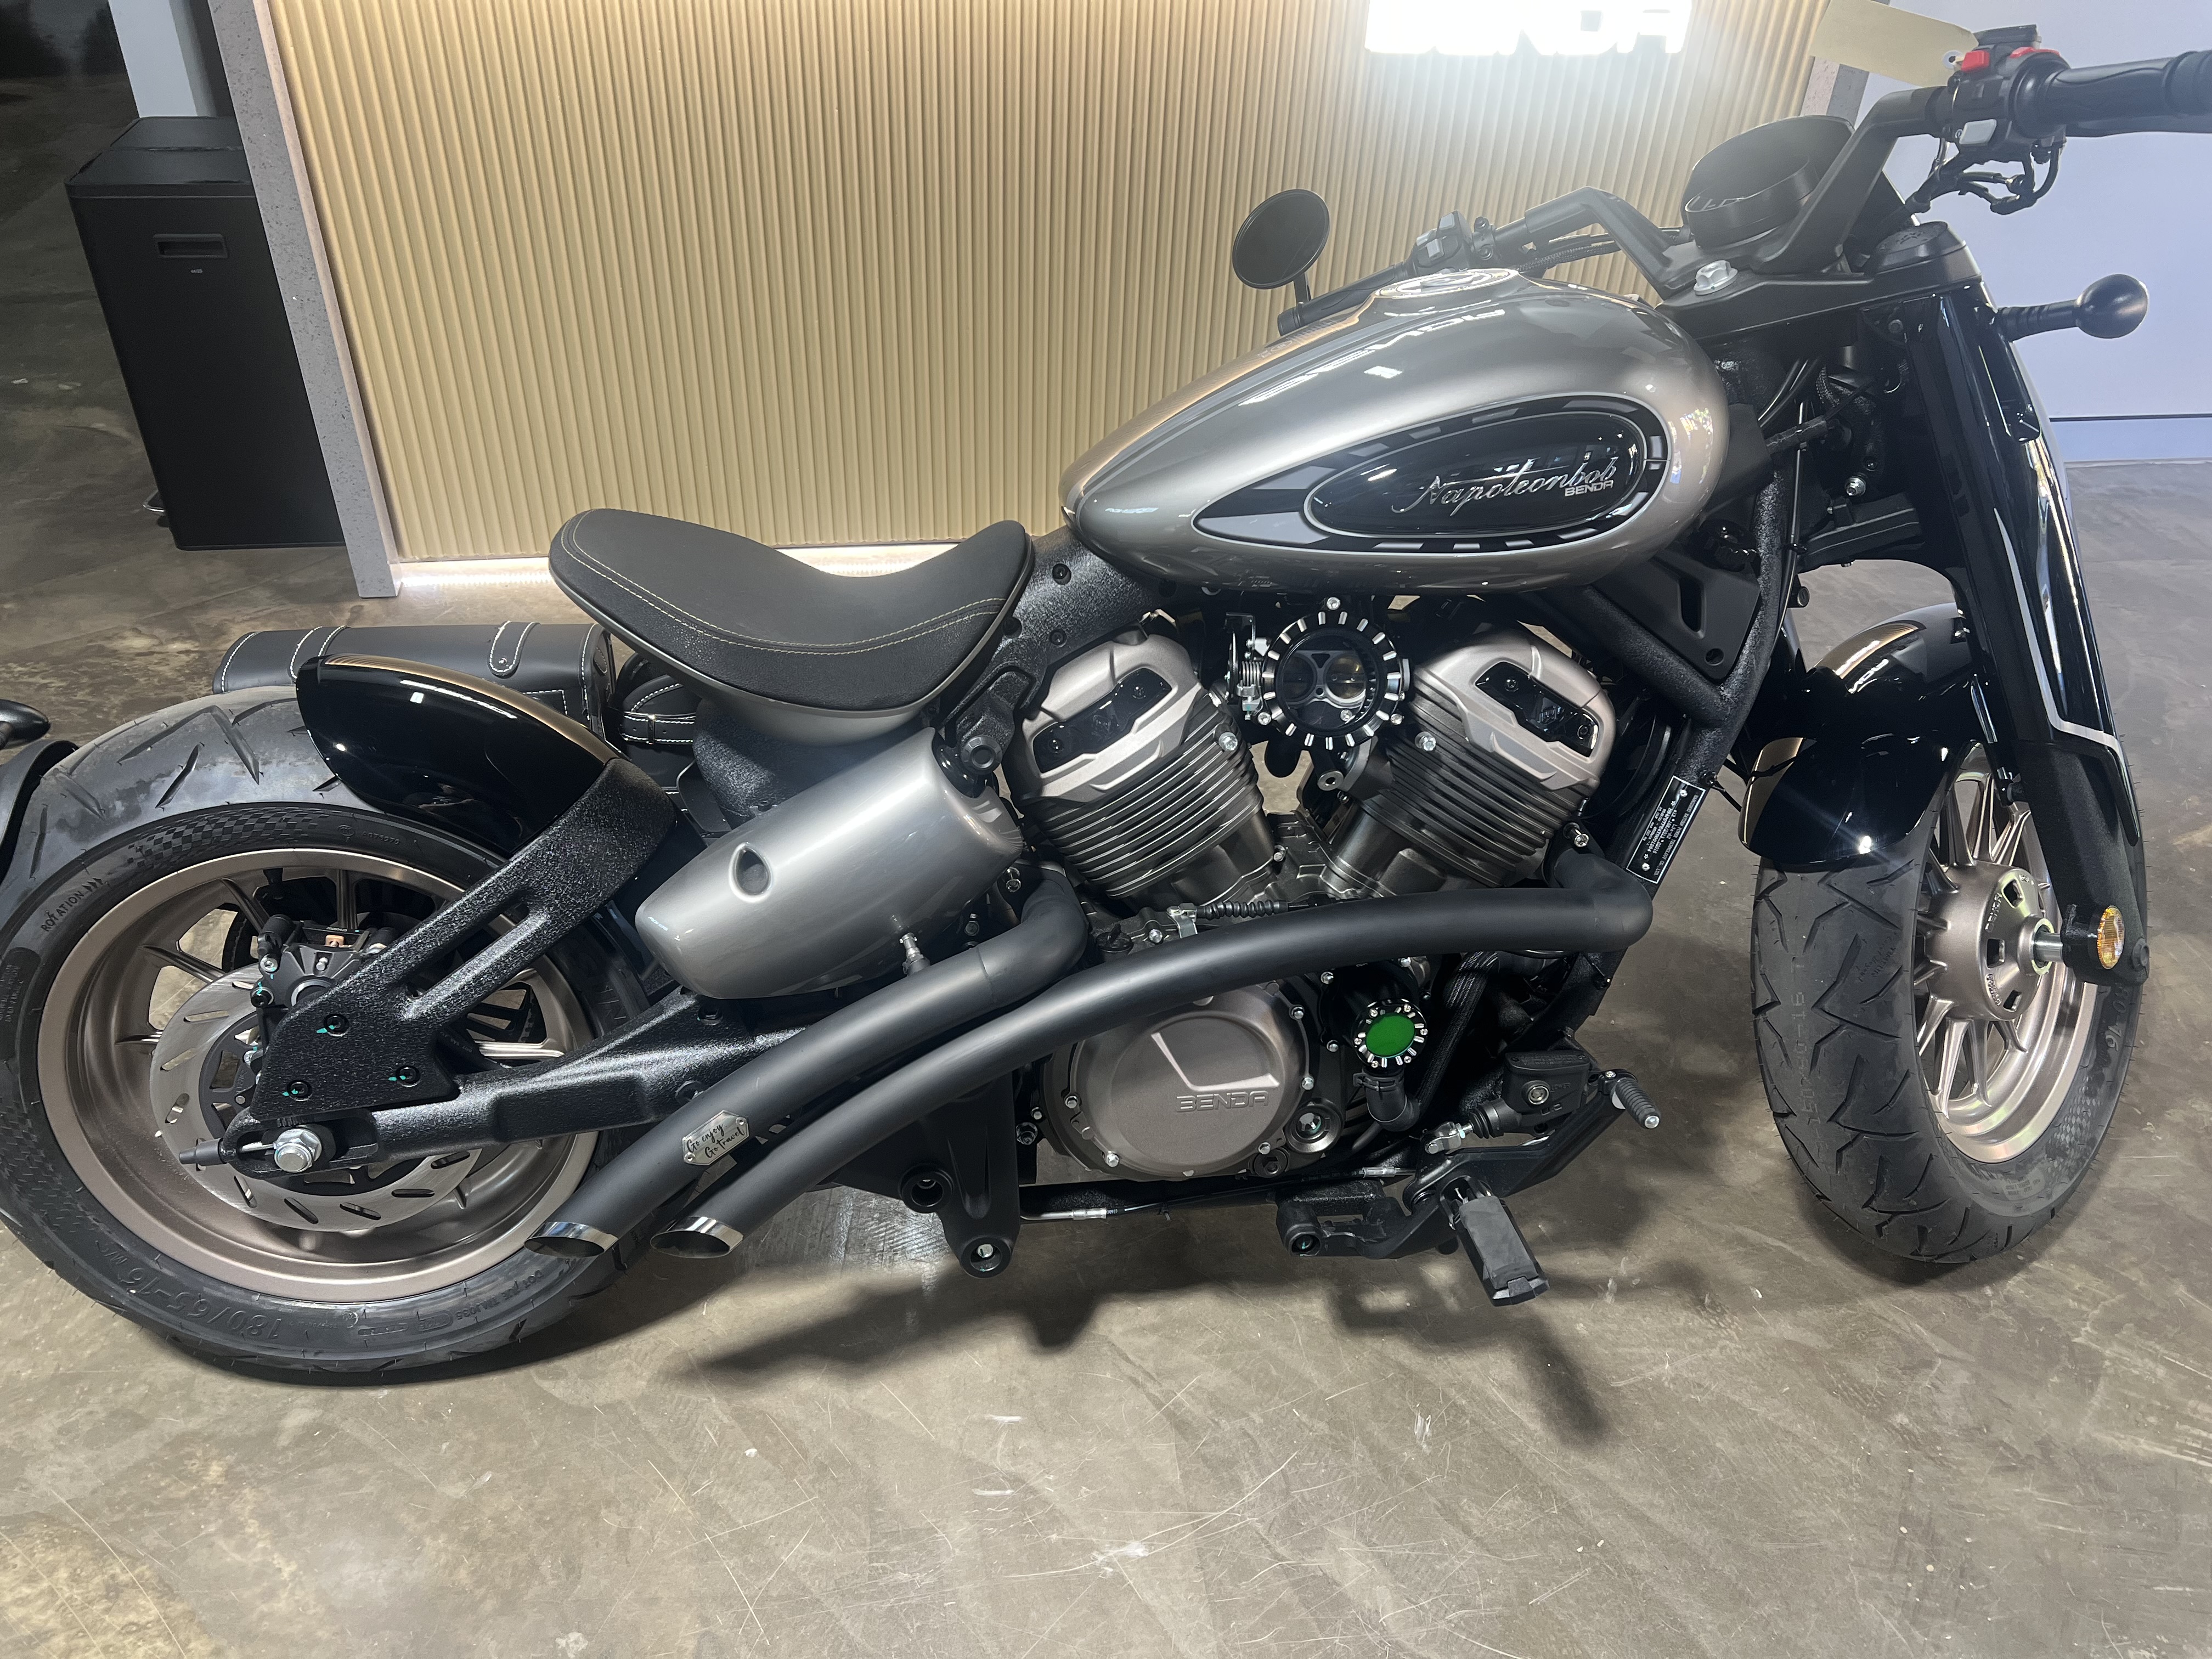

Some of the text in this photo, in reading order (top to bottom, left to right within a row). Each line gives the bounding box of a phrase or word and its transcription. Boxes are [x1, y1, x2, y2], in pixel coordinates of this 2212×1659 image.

[1565, 481, 1613, 498] BENDA
[41, 890, 84, 932] ROTATION
[1176, 1090, 1269, 1113] BENDA
[686, 1123, 724, 1153] Go enjoy
[704, 1146, 718, 1158] Go
[117, 1266, 280, 1339] 180/65-16
